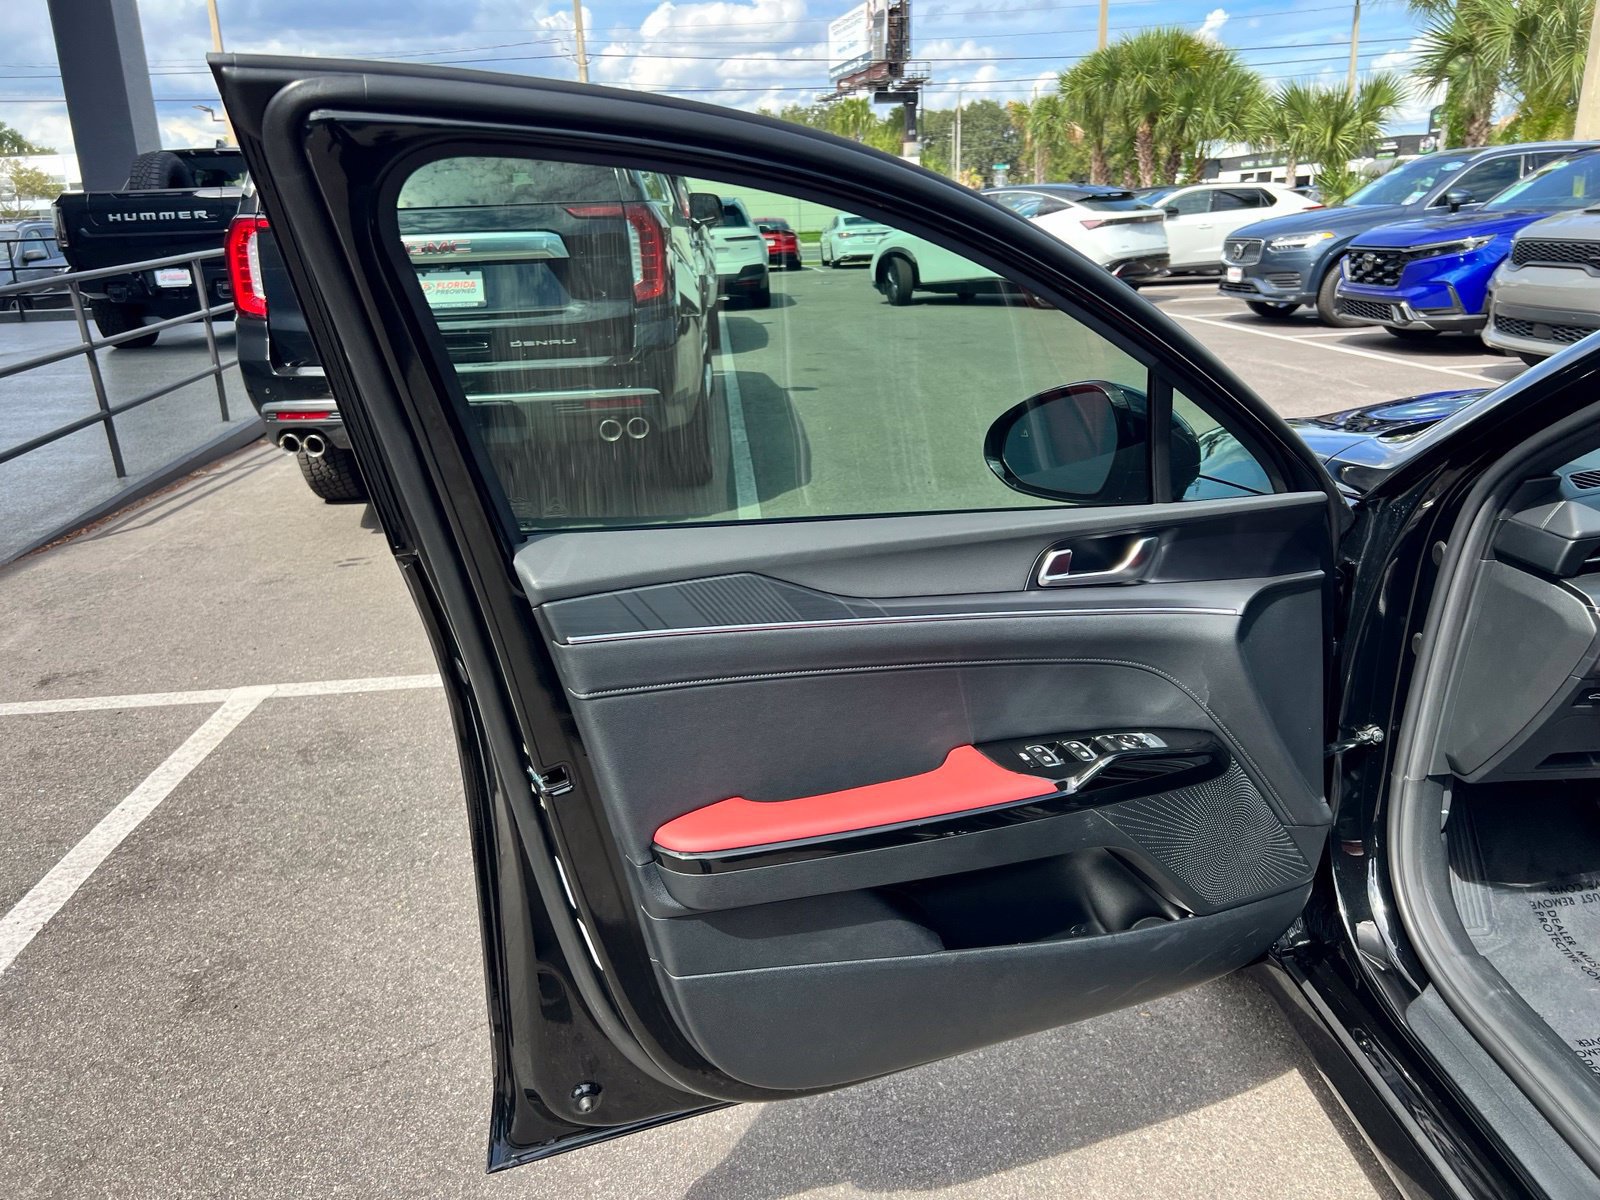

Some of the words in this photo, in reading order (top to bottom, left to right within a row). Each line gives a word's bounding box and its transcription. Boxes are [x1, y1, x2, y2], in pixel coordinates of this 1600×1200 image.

[108, 210, 208, 221] HUMMER
[404, 239, 471, 255] GMC
[436, 281, 476, 289] FLORIDA
[510, 338, 576, 347] DENALI
[1530, 897, 1575, 910] REMOVE
[1581, 893, 1600, 904] UST
[1547, 910, 1577, 945] DEALER
[1535, 911, 1582, 963] PROTECTIVE
